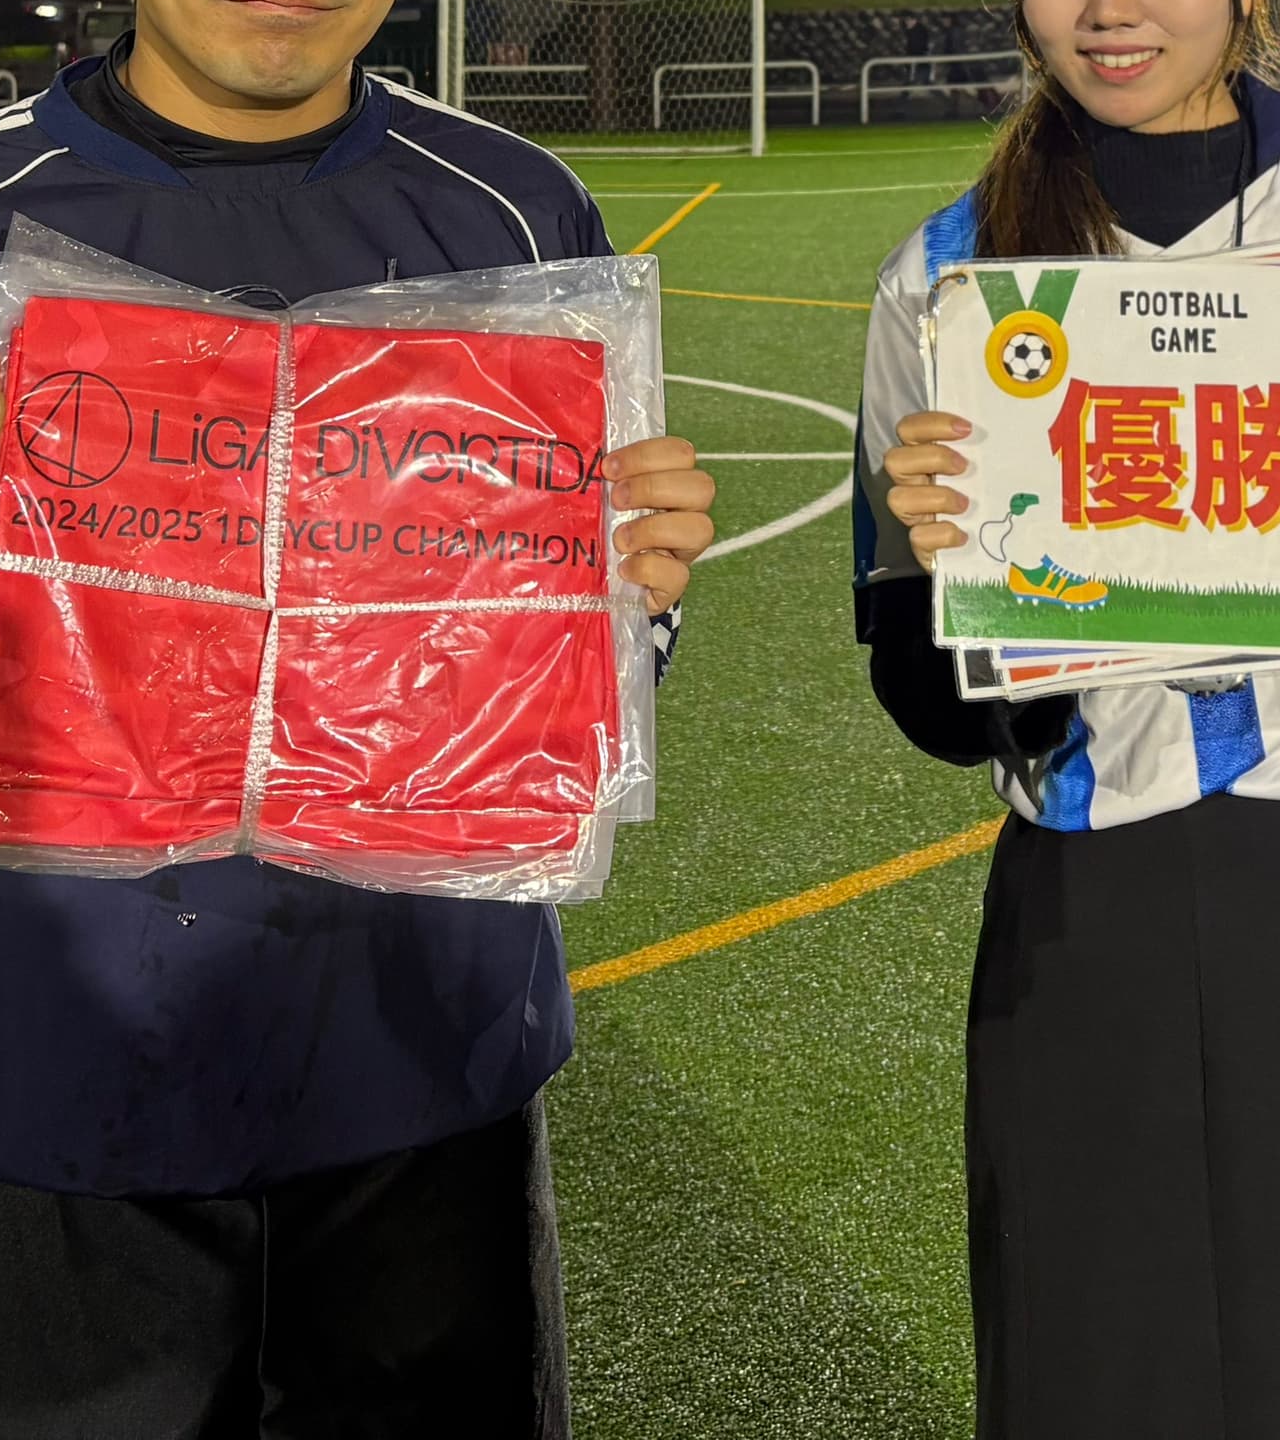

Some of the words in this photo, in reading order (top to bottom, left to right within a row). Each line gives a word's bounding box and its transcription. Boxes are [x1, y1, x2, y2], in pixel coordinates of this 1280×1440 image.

[1120, 290, 1248, 319] FOOTBALL
[1151, 326, 1217, 353] GAME
[11, 494, 203, 542] 2024/2025
[216, 513, 383, 554] 1DYCUP
